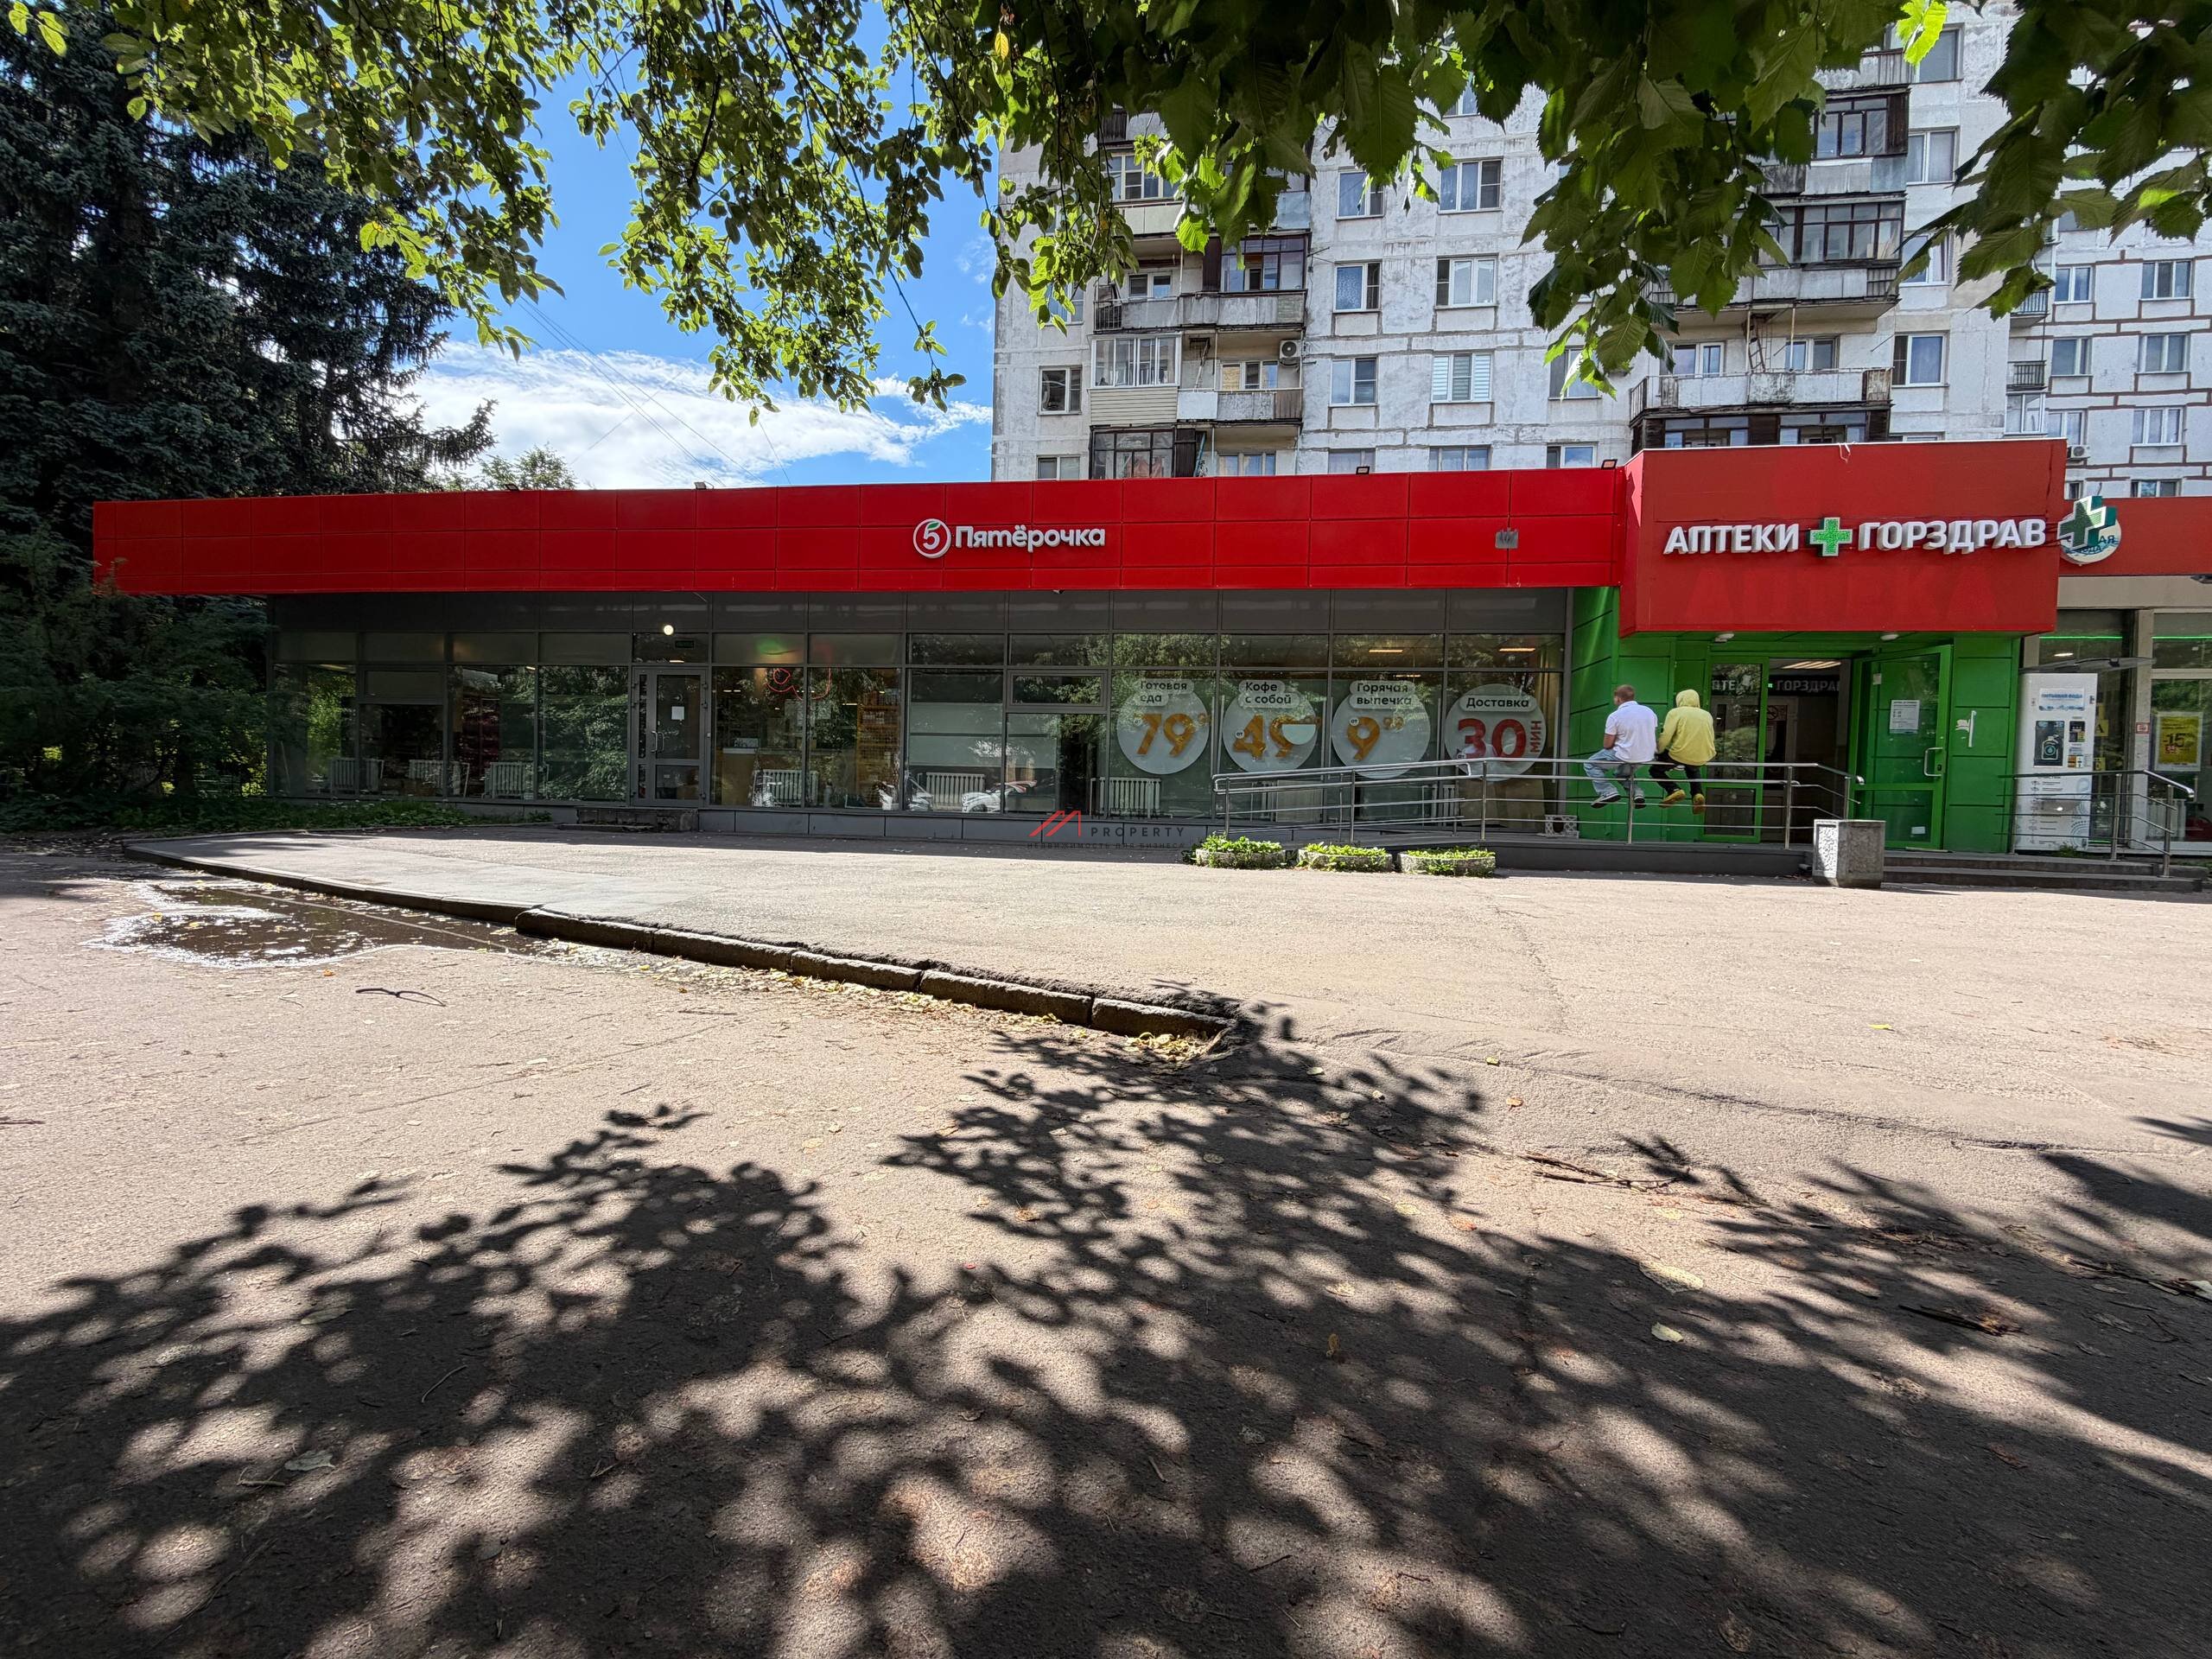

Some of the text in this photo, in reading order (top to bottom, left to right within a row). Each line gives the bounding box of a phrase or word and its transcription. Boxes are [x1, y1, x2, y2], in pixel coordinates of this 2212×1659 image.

[955, 524, 1105, 553] Пятёрочка
[1662, 518, 2047, 555] АПТЕКИ ГОРЗДРАВ
[1141, 680, 1188, 691] Готовая
[1245, 681, 1278, 693] Кофе
[1357, 683, 1408, 695] Горячая
[1141, 694, 1162, 703] еда
[1245, 694, 1292, 704] с собой
[1357, 696, 1412, 705] выпечка
[1465, 697, 1529, 709] Доставка
[1458, 718, 1527, 762] 30
